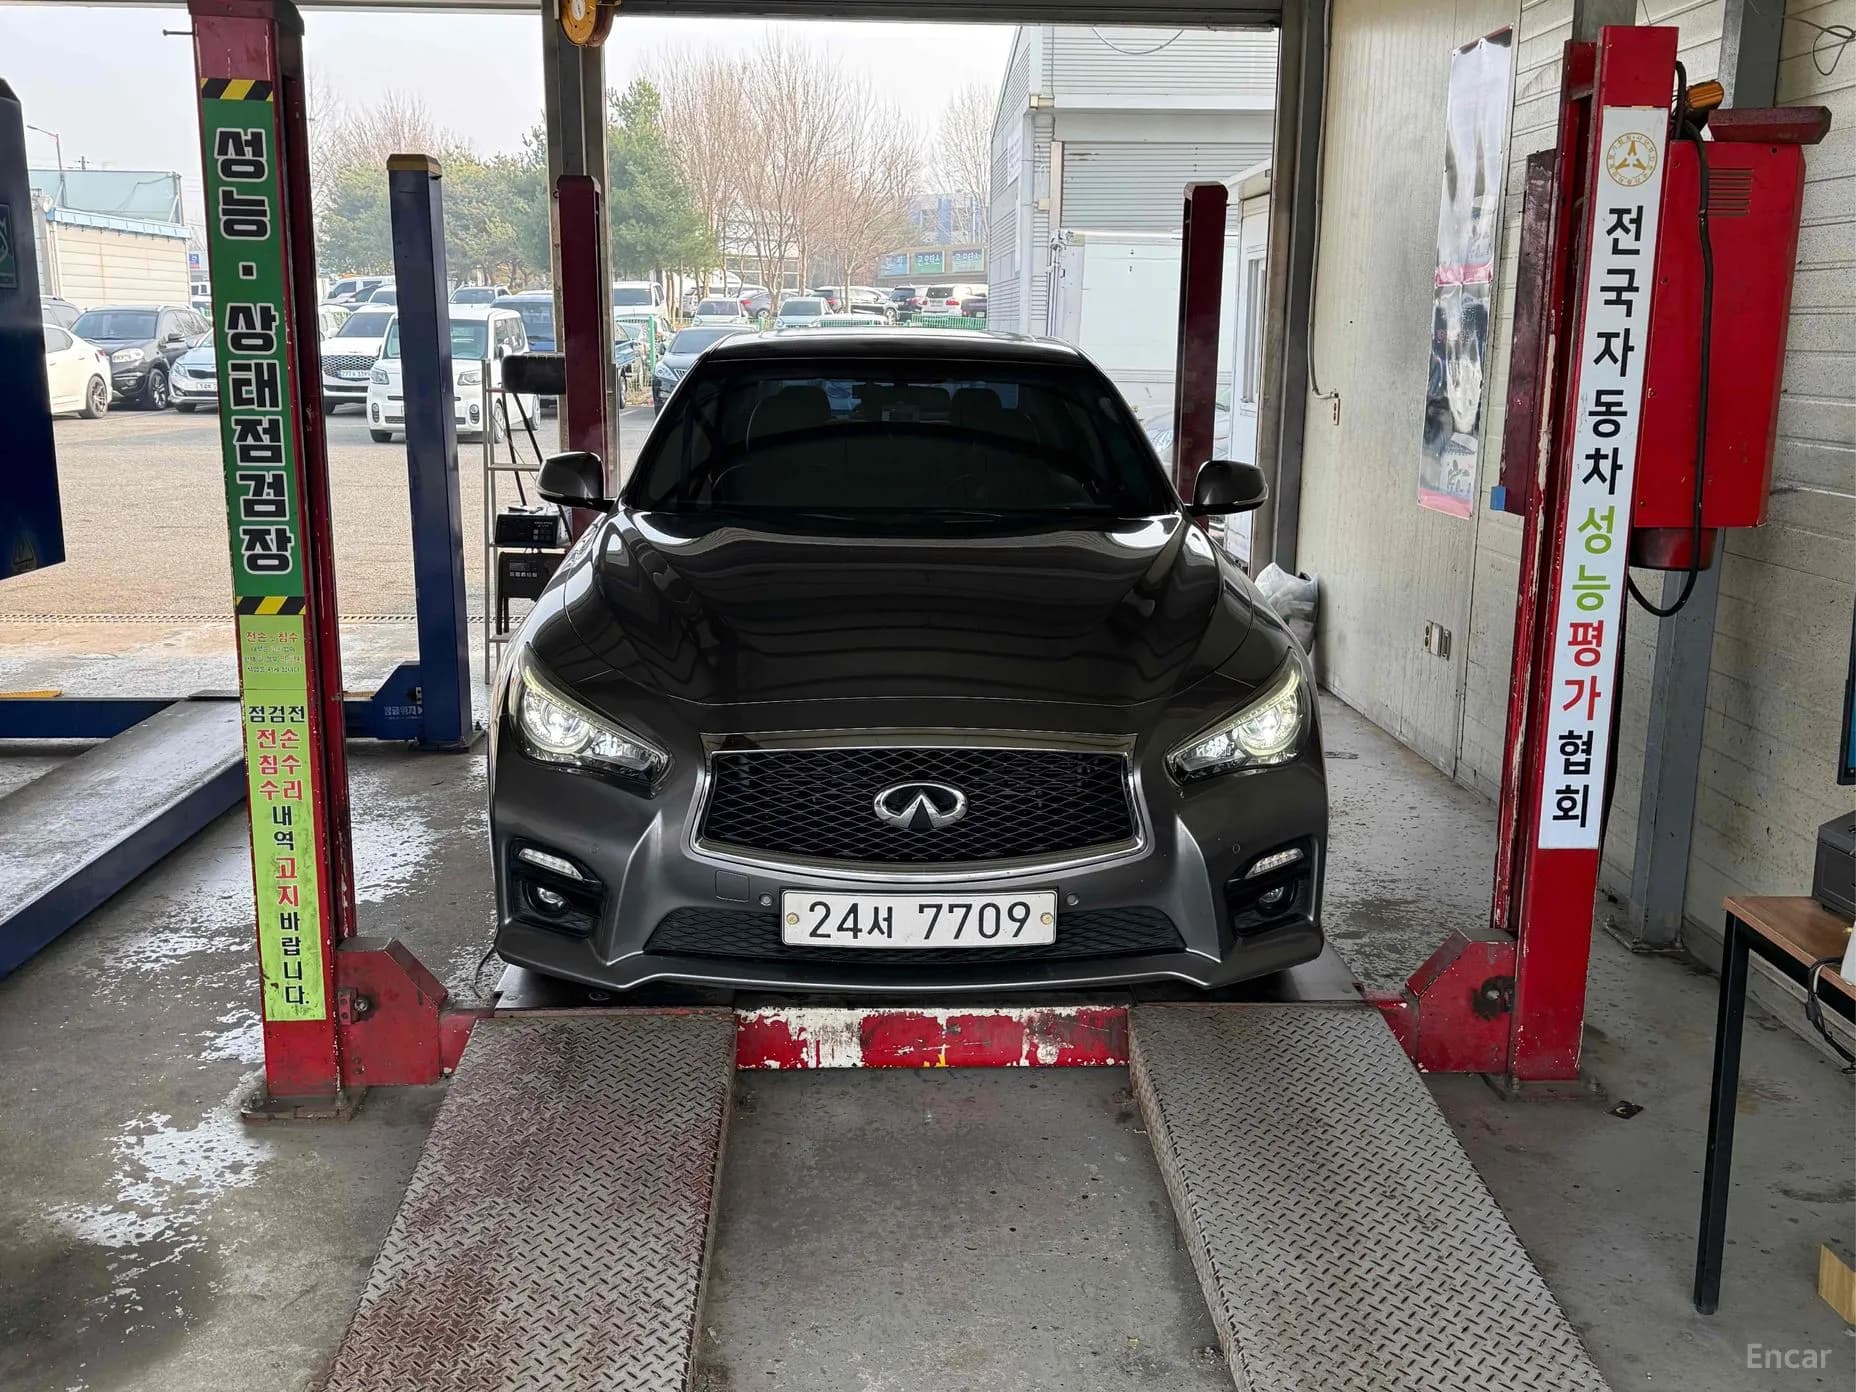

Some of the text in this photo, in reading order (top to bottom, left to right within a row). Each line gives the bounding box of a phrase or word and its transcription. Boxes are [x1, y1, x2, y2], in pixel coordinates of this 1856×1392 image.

[1552, 205, 1643, 828] 전국자동차성능평가협회
[247, 631, 268, 643] 전손
[278, 631, 298, 643] 침수
[249, 706, 305, 723] 점검전
[257, 729, 299, 749] 전손
[259, 754, 301, 775] 침수
[259, 780, 303, 801] 수리
[808, 901, 1031, 940] 24서 7709
